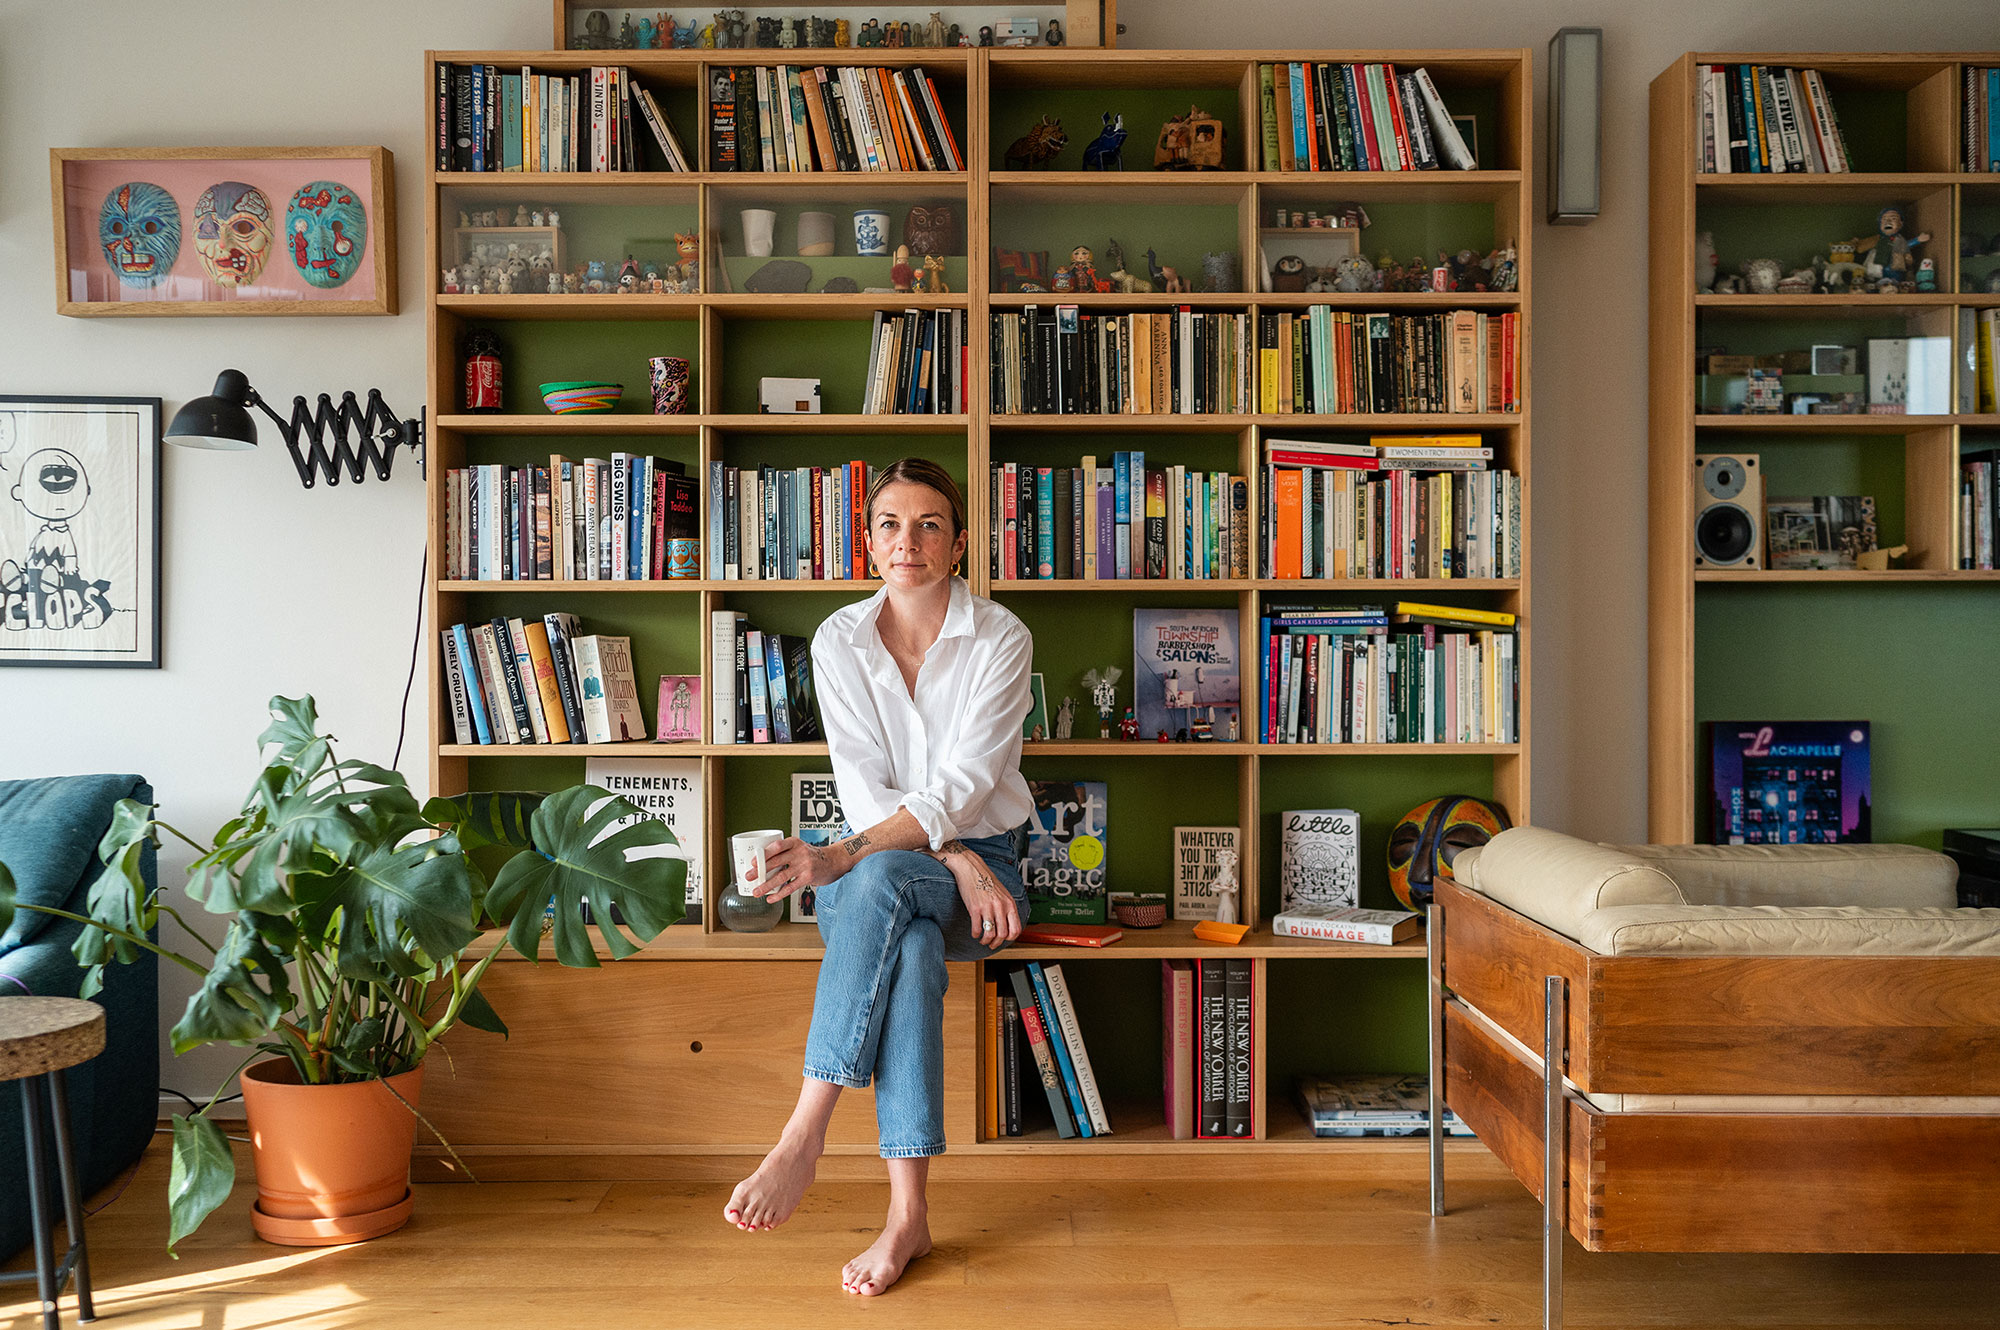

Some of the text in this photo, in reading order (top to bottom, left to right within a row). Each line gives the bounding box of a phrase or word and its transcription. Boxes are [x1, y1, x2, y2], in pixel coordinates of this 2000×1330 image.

[1345, 70, 1353, 87] JANET
[1743, 77, 1752, 102] Scamp
[594, 84, 604, 118] TIN TOYS
[860, 80, 877, 130] JOHN FANTE
[1780, 98, 1795, 132] FIVE
[1398, 148, 1408, 166] Muse
[614, 459, 624, 480] BIG
[586, 464, 596, 504] LUSTER
[676, 490, 688, 500] Lisa
[834, 478, 840, 488] LA
[1022, 470, 1033, 500] CÉLINE
[614, 481, 624, 520] SWISS
[670, 501, 692, 512] Taddeo
[1008, 483, 1016, 512] Frida
[1134, 480, 1142, 518] GRENVILLE
[484, 626, 494, 654] Sagan
[1156, 626, 1219, 643] TOWNSHIP
[1158, 641, 1216, 650] BARBERSHOPS
[496, 624, 520, 700] Alexander McQueen
[514, 632, 536, 696] Leigh Bowery
[601, 645, 629, 674] Kenneth
[736, 636, 745, 671] MOLE PEOPLE
[771, 638, 780, 667] CHARLES
[1162, 650, 1216, 664] SALONS
[447, 635, 464, 718] LONELY CRUSADE
[603, 674, 636, 699] Williams
[567, 698, 575, 717] SMITH
[1743, 726, 1842, 758] LACHAPELLE
[606, 776, 692, 792] TENEMENTS,
[623, 794, 674, 808] OWERS
[1732, 788, 1741, 833] HOTEL
[1286, 815, 1354, 836] little
[1050, 840, 1068, 862] is
[1180, 832, 1234, 848] WHATEVER
[1286, 834, 1354, 844] WINDOWS
[1180, 848, 1200, 864] YOU
[1050, 908, 1072, 916] Jeremy
[1290, 926, 1366, 941] RUMMAGE
[1043, 1003, 1054, 1021] Changing
[1178, 978, 1187, 1049] LIFE MEETS ART
[1026, 1011, 1042, 1042] SILAS?
[1051, 975, 1100, 1116] DON McCULLIN IN ENGLAND
[1203, 1051, 1210, 1062] OF
[1211, 994, 1224, 1102] THE NEW YORKER
[1228, 1052, 1235, 1062] OF
[1236, 996, 1250, 1104] THE NEW YORKER
